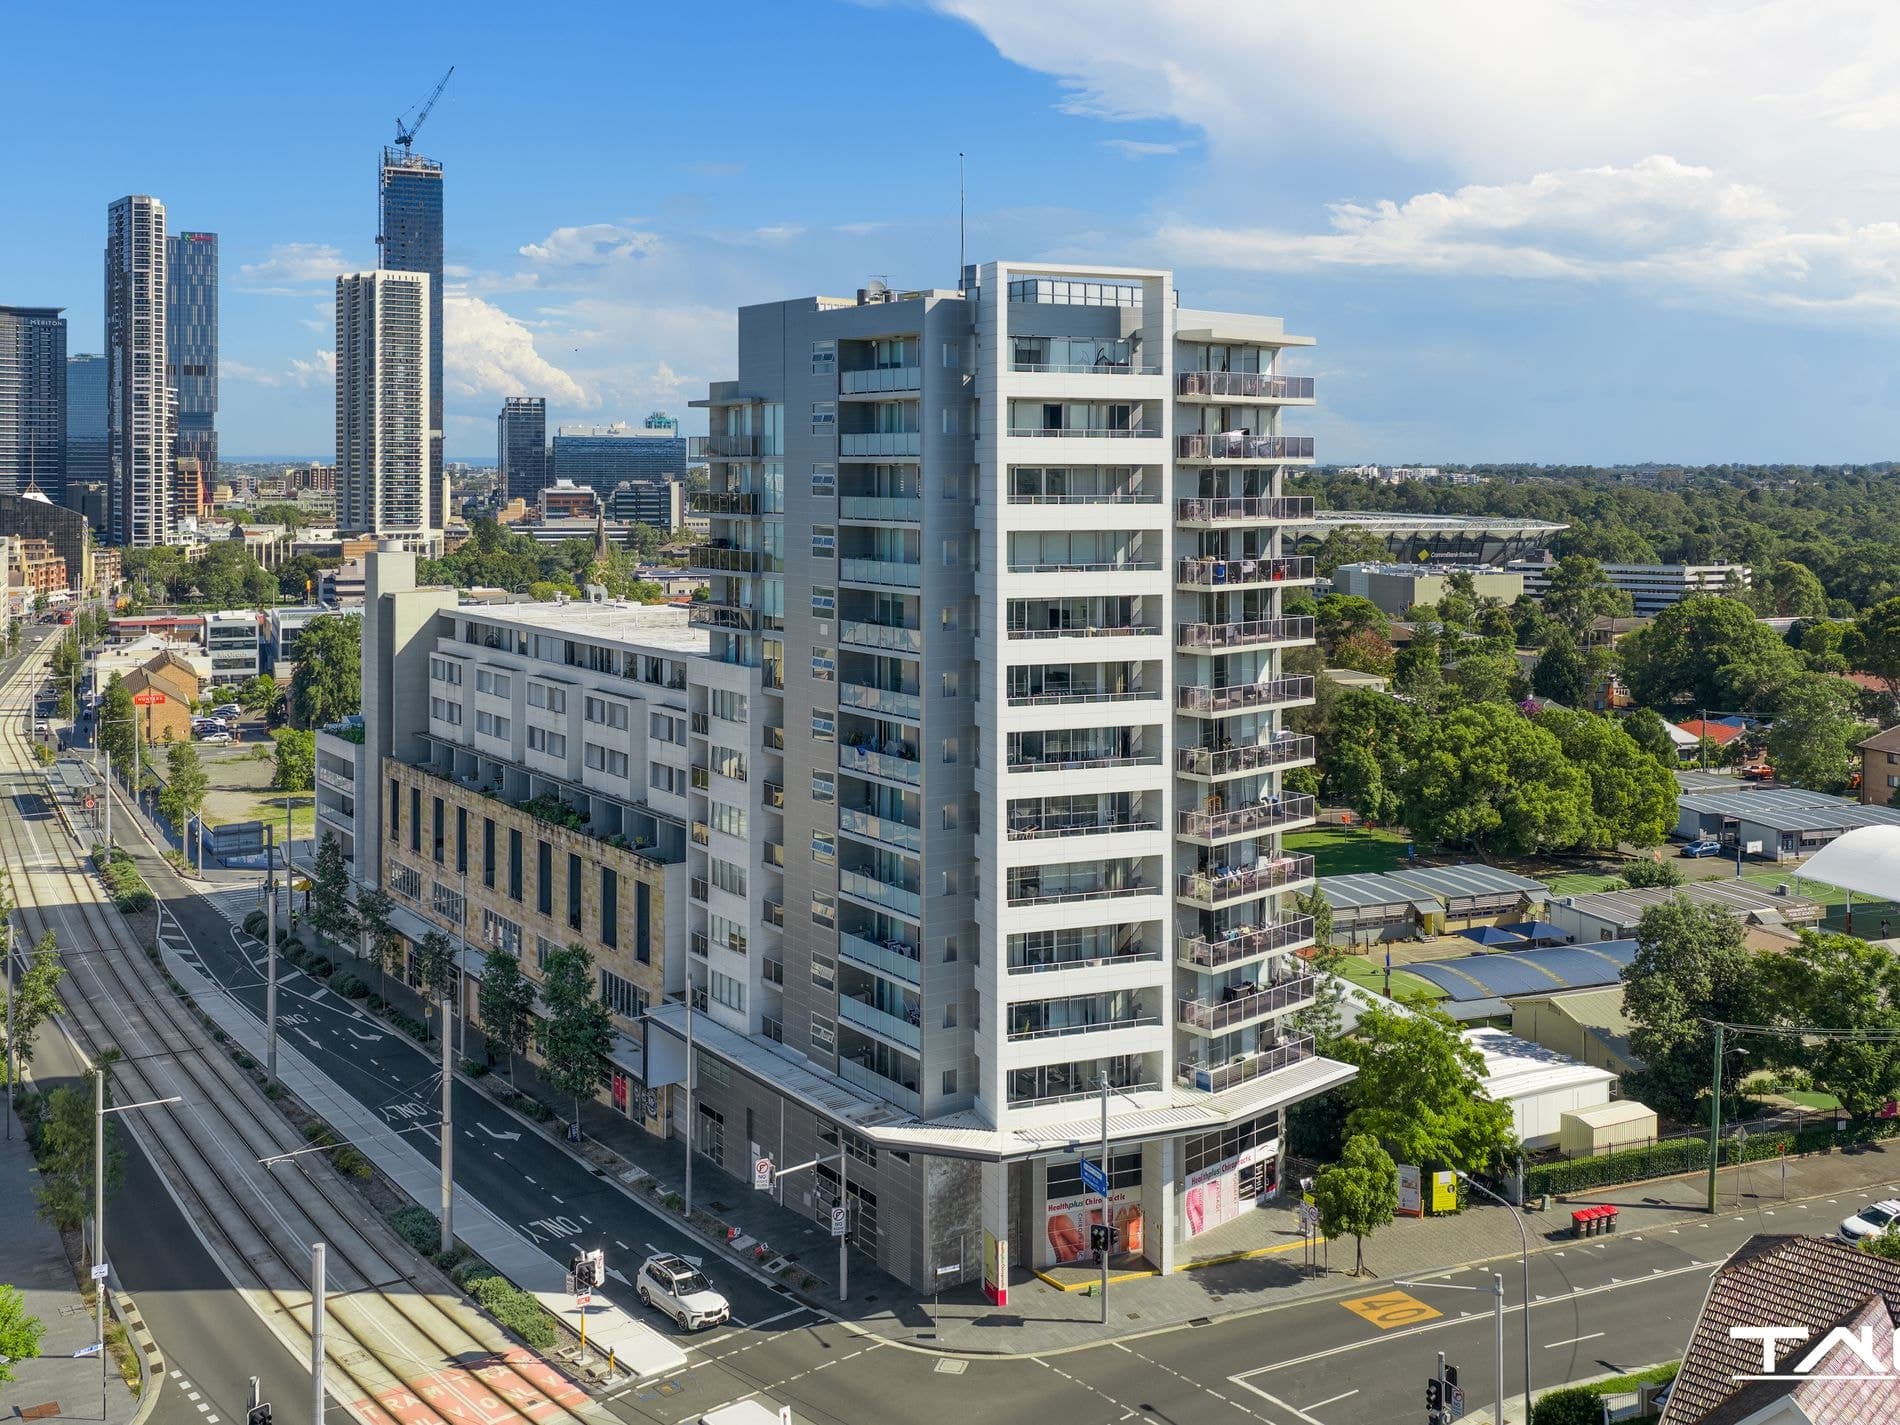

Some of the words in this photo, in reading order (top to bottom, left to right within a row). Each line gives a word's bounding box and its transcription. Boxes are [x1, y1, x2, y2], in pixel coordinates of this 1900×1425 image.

[379, 1102, 428, 1122] ONLY
[1191, 1168, 1220, 1185] Healthplus
[1047, 1200, 1084, 1212] Healthplus
[1085, 1193, 1126, 1206] Chiroactic
[519, 1216, 583, 1243] ONLY
[1360, 1300, 1427, 1321] 40
[360, 1386, 445, 1419] TRAM
